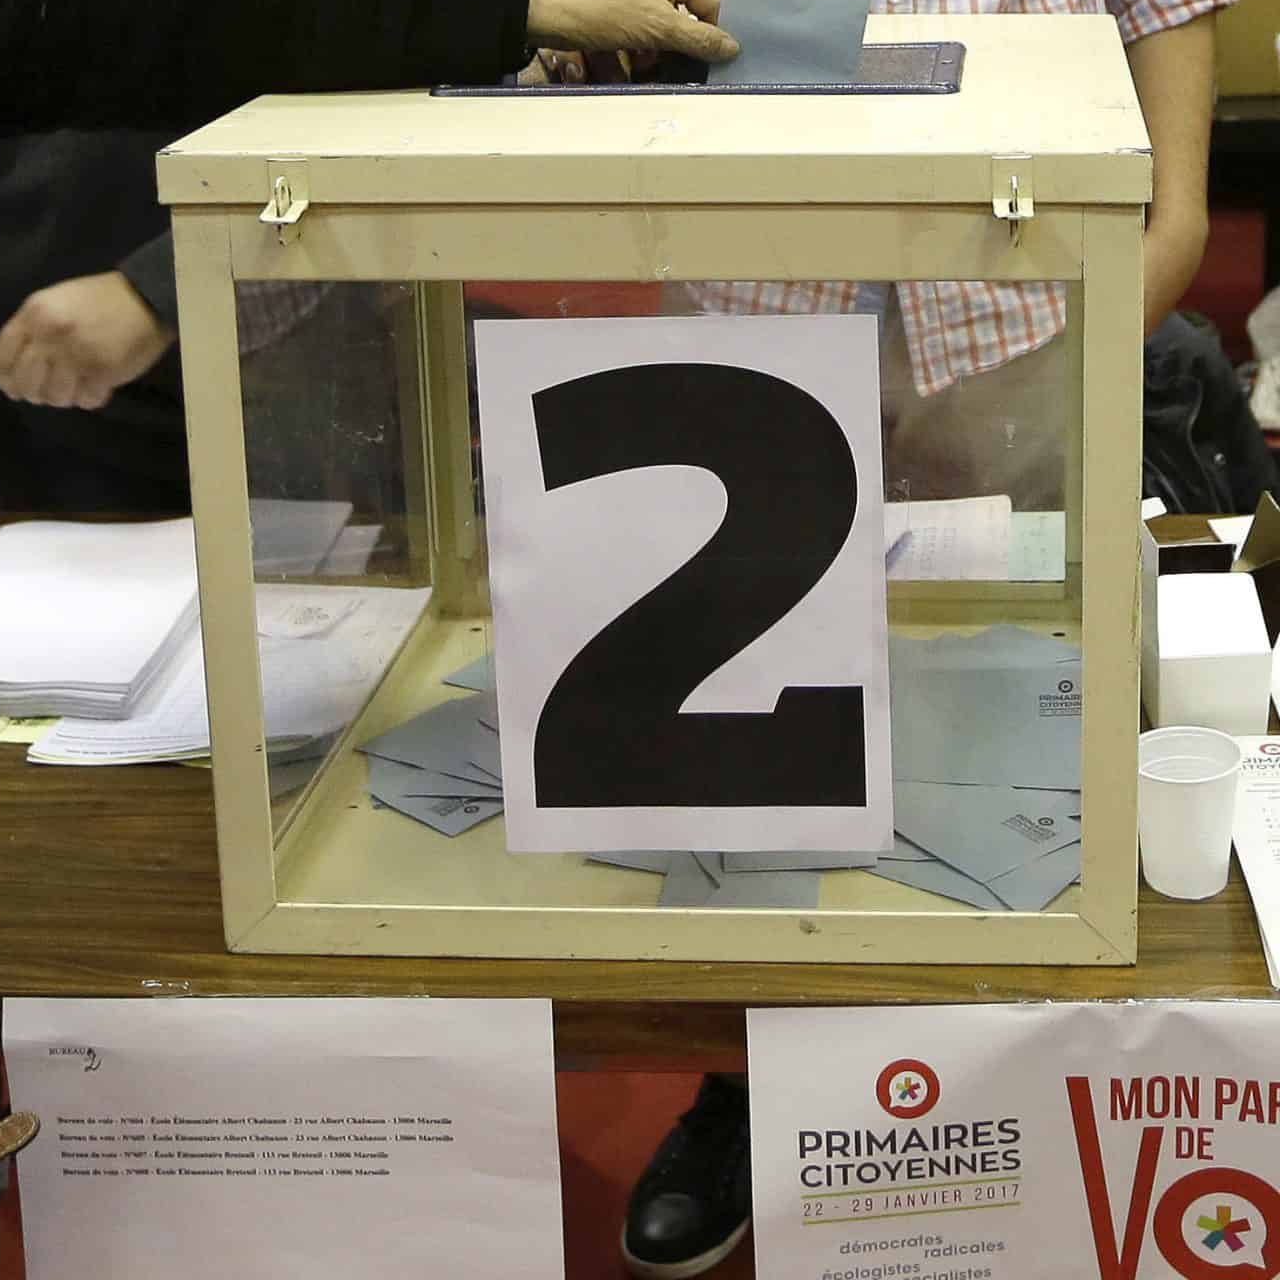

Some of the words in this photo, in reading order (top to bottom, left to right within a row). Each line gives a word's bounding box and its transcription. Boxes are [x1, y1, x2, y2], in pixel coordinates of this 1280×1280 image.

[531, 361, 867, 808] 2
[84, 1047, 102, 1072] 2
[1109, 1075, 1200, 1121] MON
[799, 1118, 1021, 1159] PRIMAIRES
[1175, 1126, 1214, 1160] DE
[800, 1149, 1021, 1188] CITOYENNES
[803, 1202, 824, 1217] 22
[852, 1197, 873, 1213] 29
[882, 1188, 962, 1210] JANVIER
[974, 1183, 1020, 1202] 2017
[839, 1233, 944, 1255] démocrates
[924, 1240, 1007, 1259] radicales
[821, 1262, 921, 1280] écologistes
